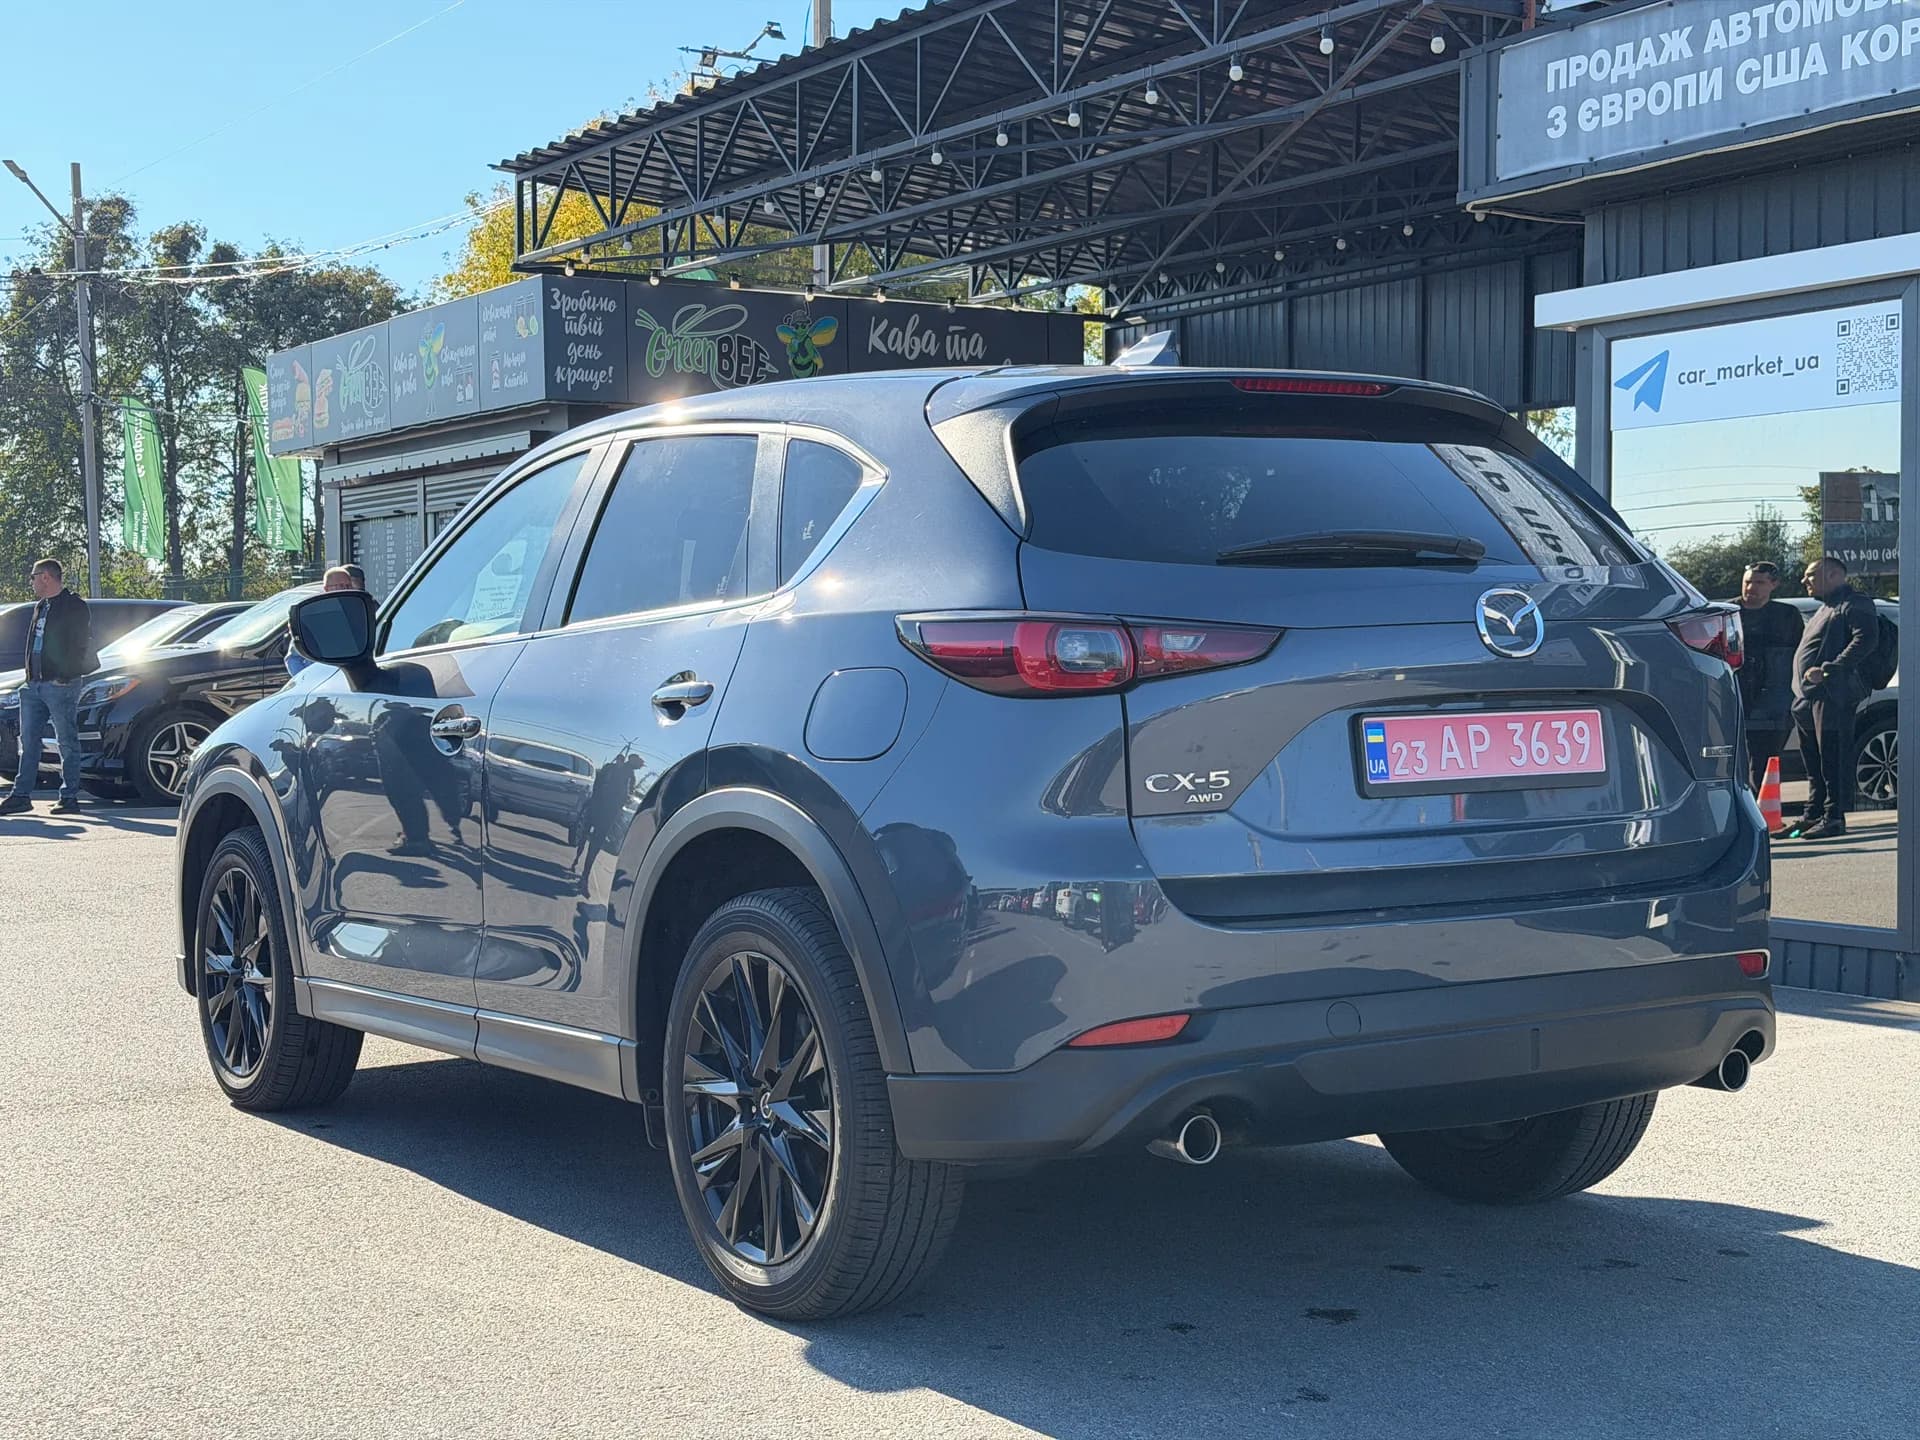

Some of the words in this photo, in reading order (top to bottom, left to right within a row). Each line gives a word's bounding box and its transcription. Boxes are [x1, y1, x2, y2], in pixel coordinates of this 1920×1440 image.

[1547, 25, 1694, 92] ПРОДАЖ
[1547, 105, 1568, 139] З
[1578, 66, 1723, 132] ЄВРОПИ
[1735, 42, 1828, 94] США
[1841, 17, 1920, 71] КОР
[551, 288, 616, 319] Зробимо
[565, 315, 605, 336] твій
[868, 314, 940, 360] Кава
[567, 342, 603, 364] день
[556, 366, 614, 391] краще!
[1678, 354, 1819, 386] car_market_ua
[1369, 760, 1387, 773] UA
[1391, 741, 1429, 776] 23
[1440, 724, 1491, 770] AP
[1506, 720, 1591, 767] 3639
[1145, 770, 1230, 793] CX-5
[1186, 792, 1223, 803] AWD
